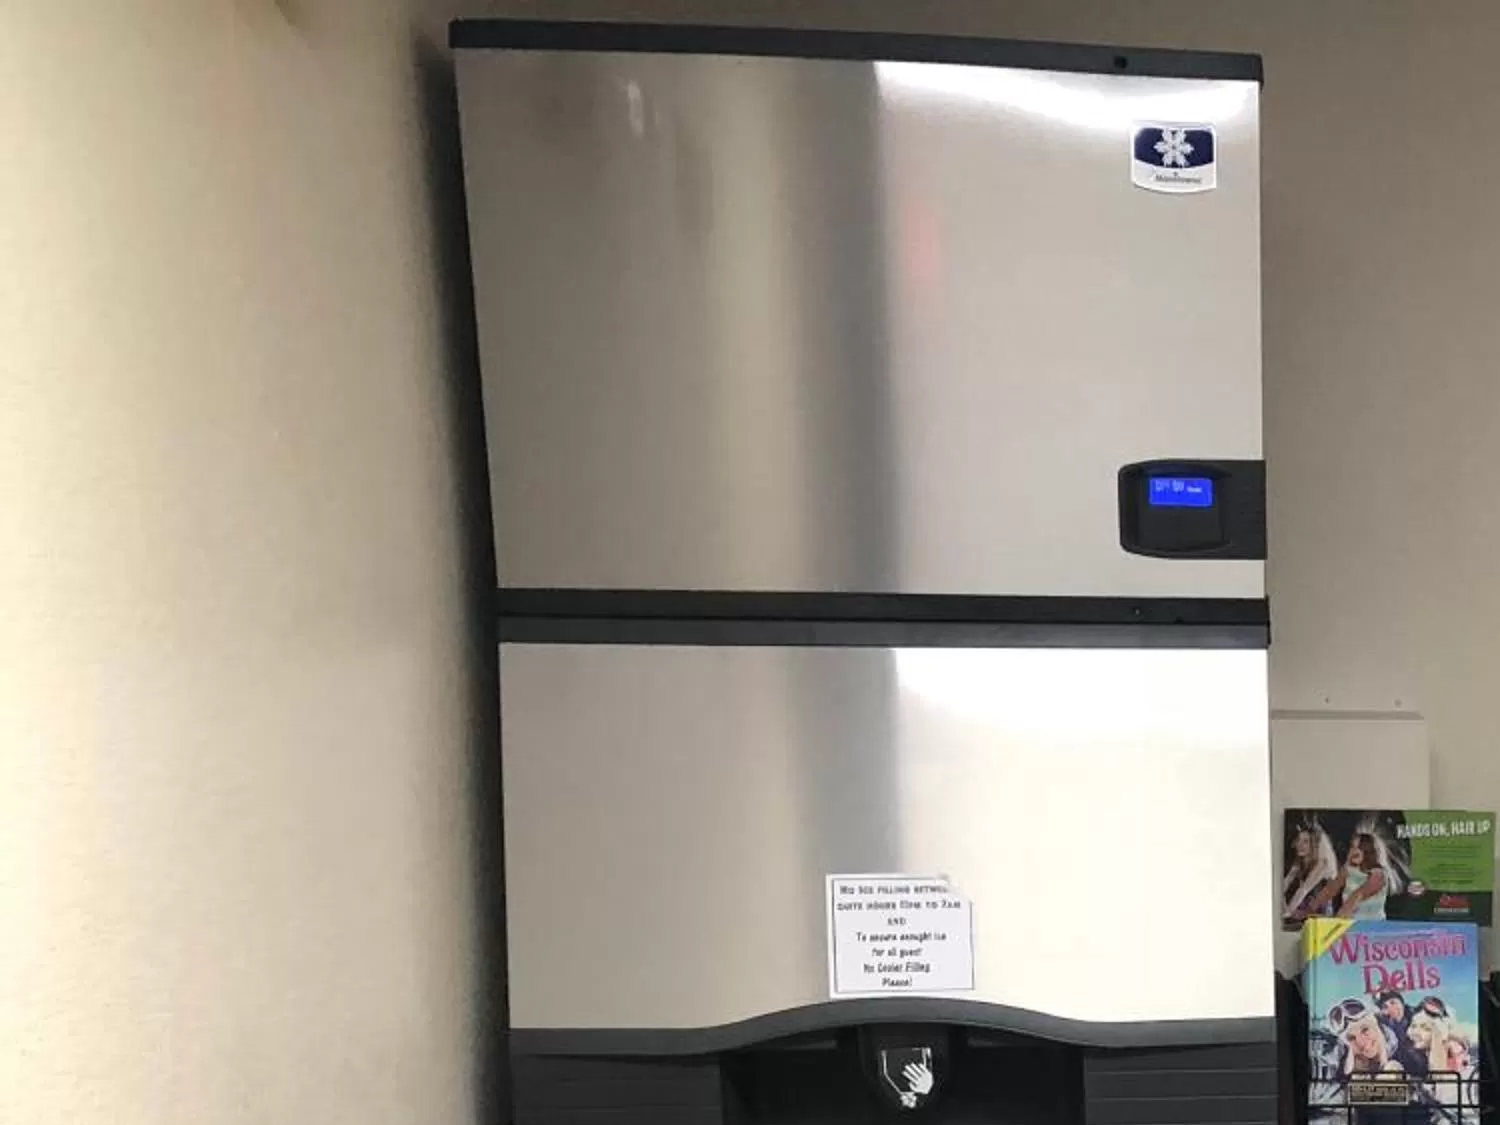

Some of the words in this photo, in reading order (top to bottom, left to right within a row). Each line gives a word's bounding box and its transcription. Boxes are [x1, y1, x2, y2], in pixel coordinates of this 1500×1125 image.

[1396, 822, 1424, 840] HANDS
[1450, 821, 1475, 836] HAIR
[1477, 820, 1491, 834] UP
[1329, 931, 1466, 965] Wisconsin
[1362, 960, 1441, 995] Dells
